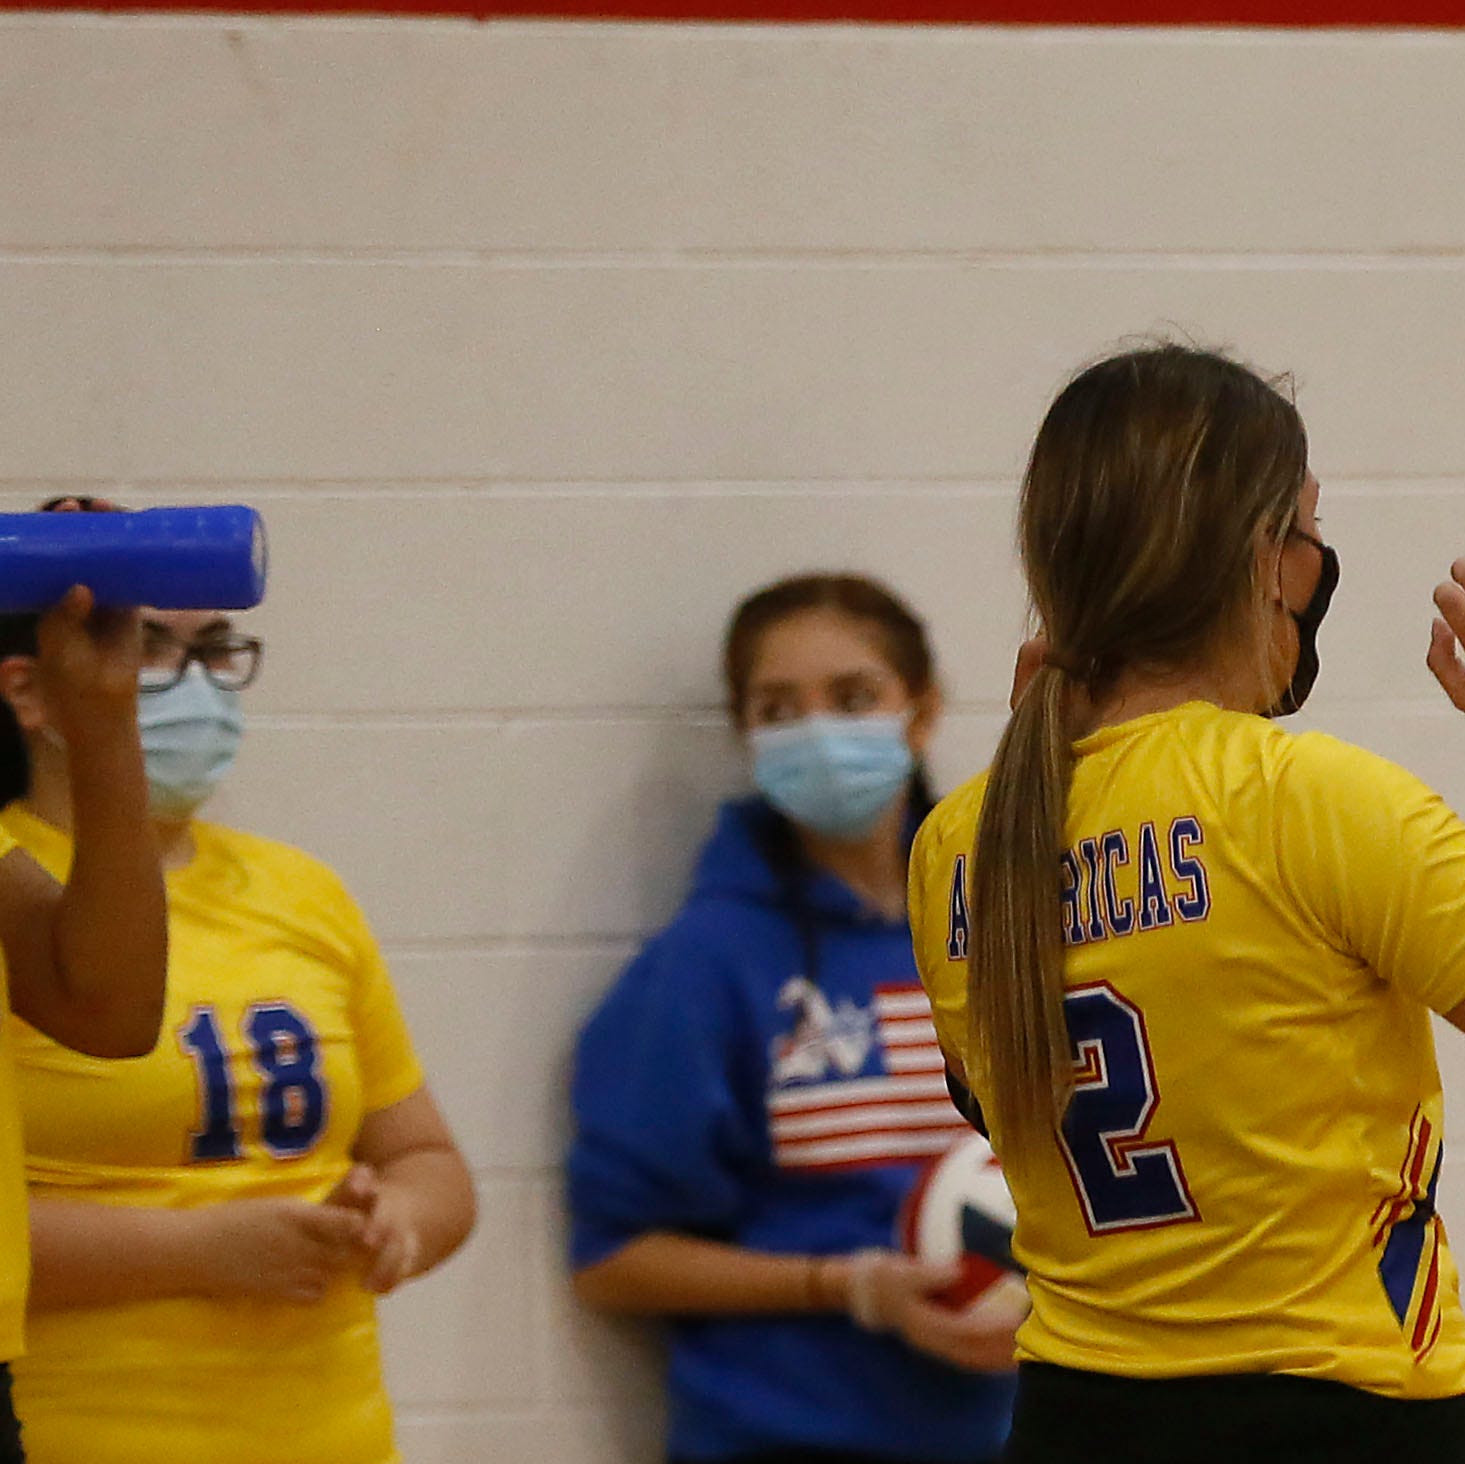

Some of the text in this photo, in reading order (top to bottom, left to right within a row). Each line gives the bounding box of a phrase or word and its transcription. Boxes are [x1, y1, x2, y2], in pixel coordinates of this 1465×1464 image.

[947, 816, 1212, 961] ARICAS
[178, 1000, 331, 1160] 18
[1056, 978, 1203, 1238] 2
